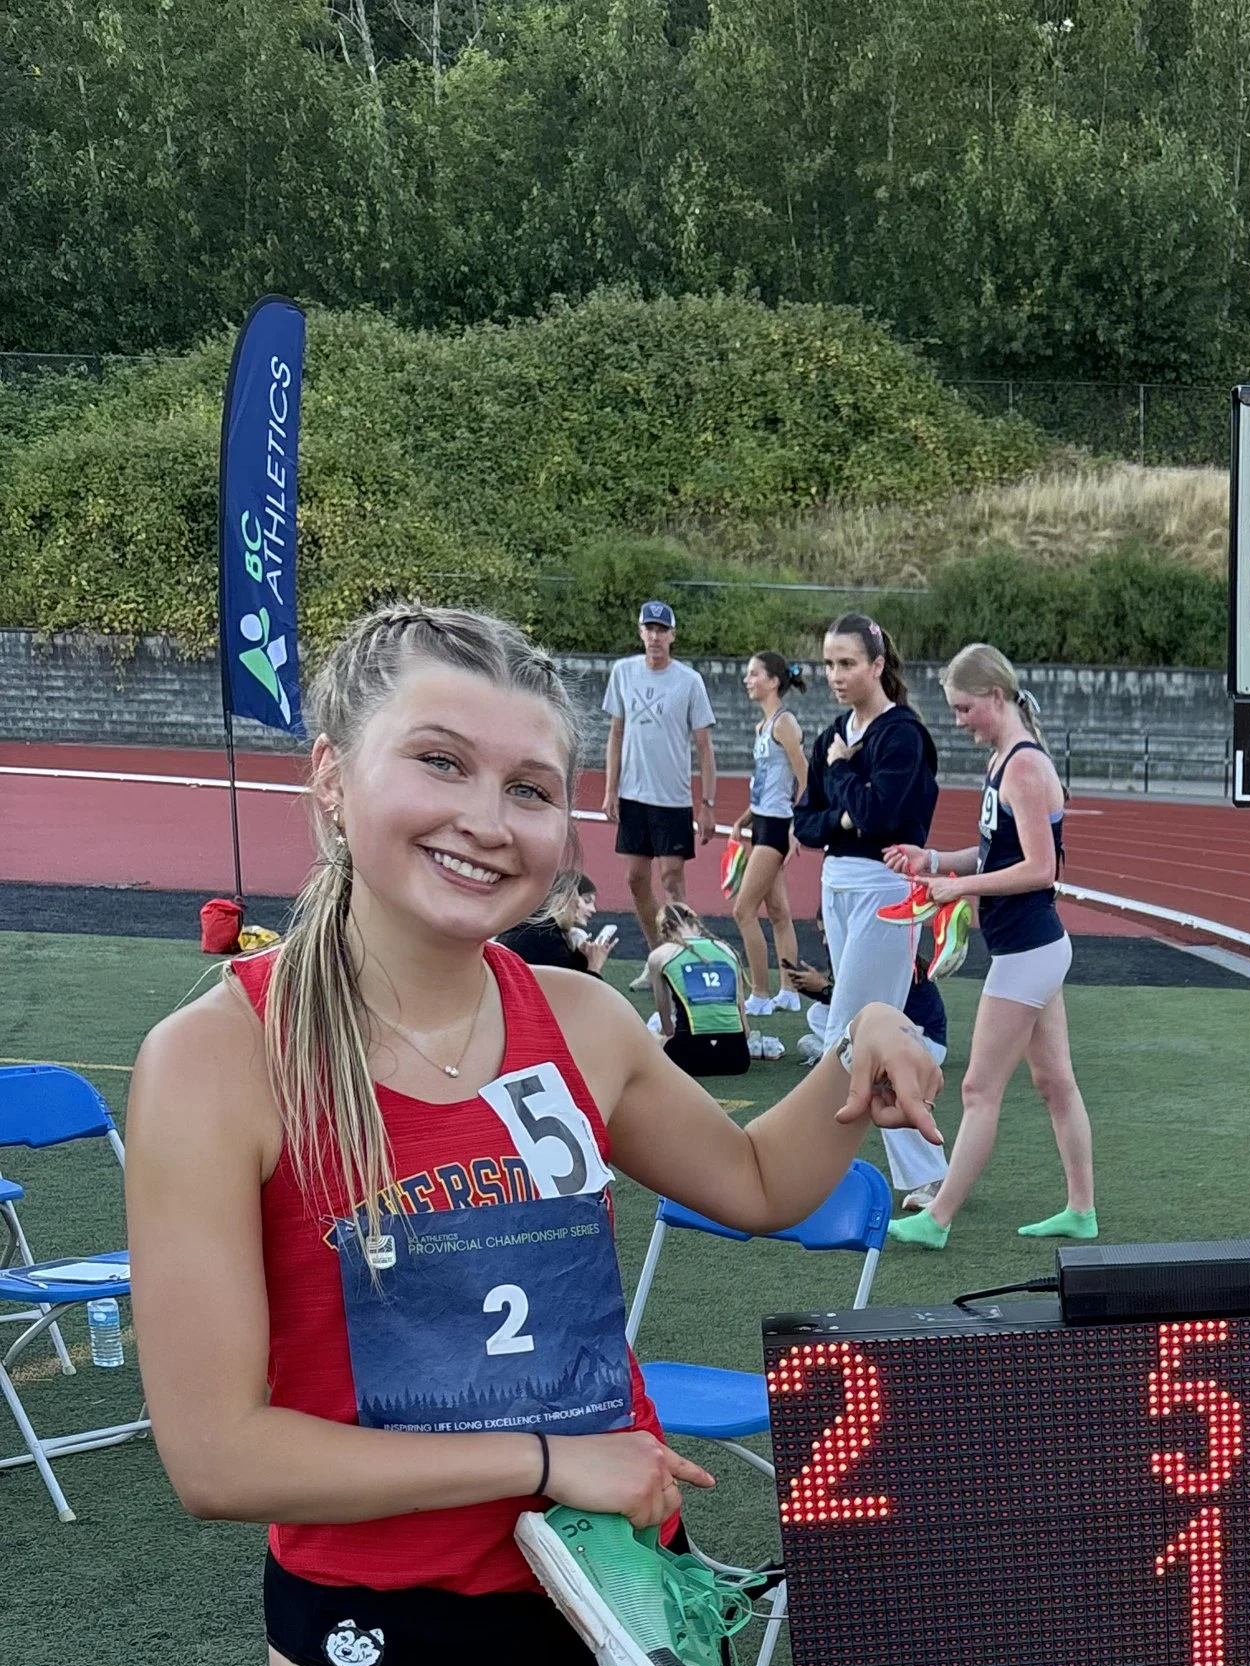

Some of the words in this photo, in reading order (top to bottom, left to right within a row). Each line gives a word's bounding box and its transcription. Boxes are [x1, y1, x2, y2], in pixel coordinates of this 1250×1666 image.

[263, 355, 292, 606] ATHLETICS
[240, 509, 263, 584] BC
[701, 972, 721, 987] 12
[503, 1073, 589, 1196] 5
[408, 1237, 484, 1256] PROVINCIAL
[485, 1227, 569, 1248] CHAMPIONSHIP
[569, 1222, 601, 1238] SERIES
[420, 1232, 459, 1244] ATHLETICS
[482, 1283, 535, 1357] 2
[384, 1422, 432, 1433] INSPIRING
[433, 1421, 452, 1432] LIFE
[454, 1419, 483, 1432] LONG
[484, 1414, 542, 1429] EXCELLENCE
[542, 1406, 585, 1423] THROUGH
[585, 1398, 624, 1414] ATHLETICS
[767, 1342, 889, 1523] 2
[1148, 1319, 1243, 1495] 5
